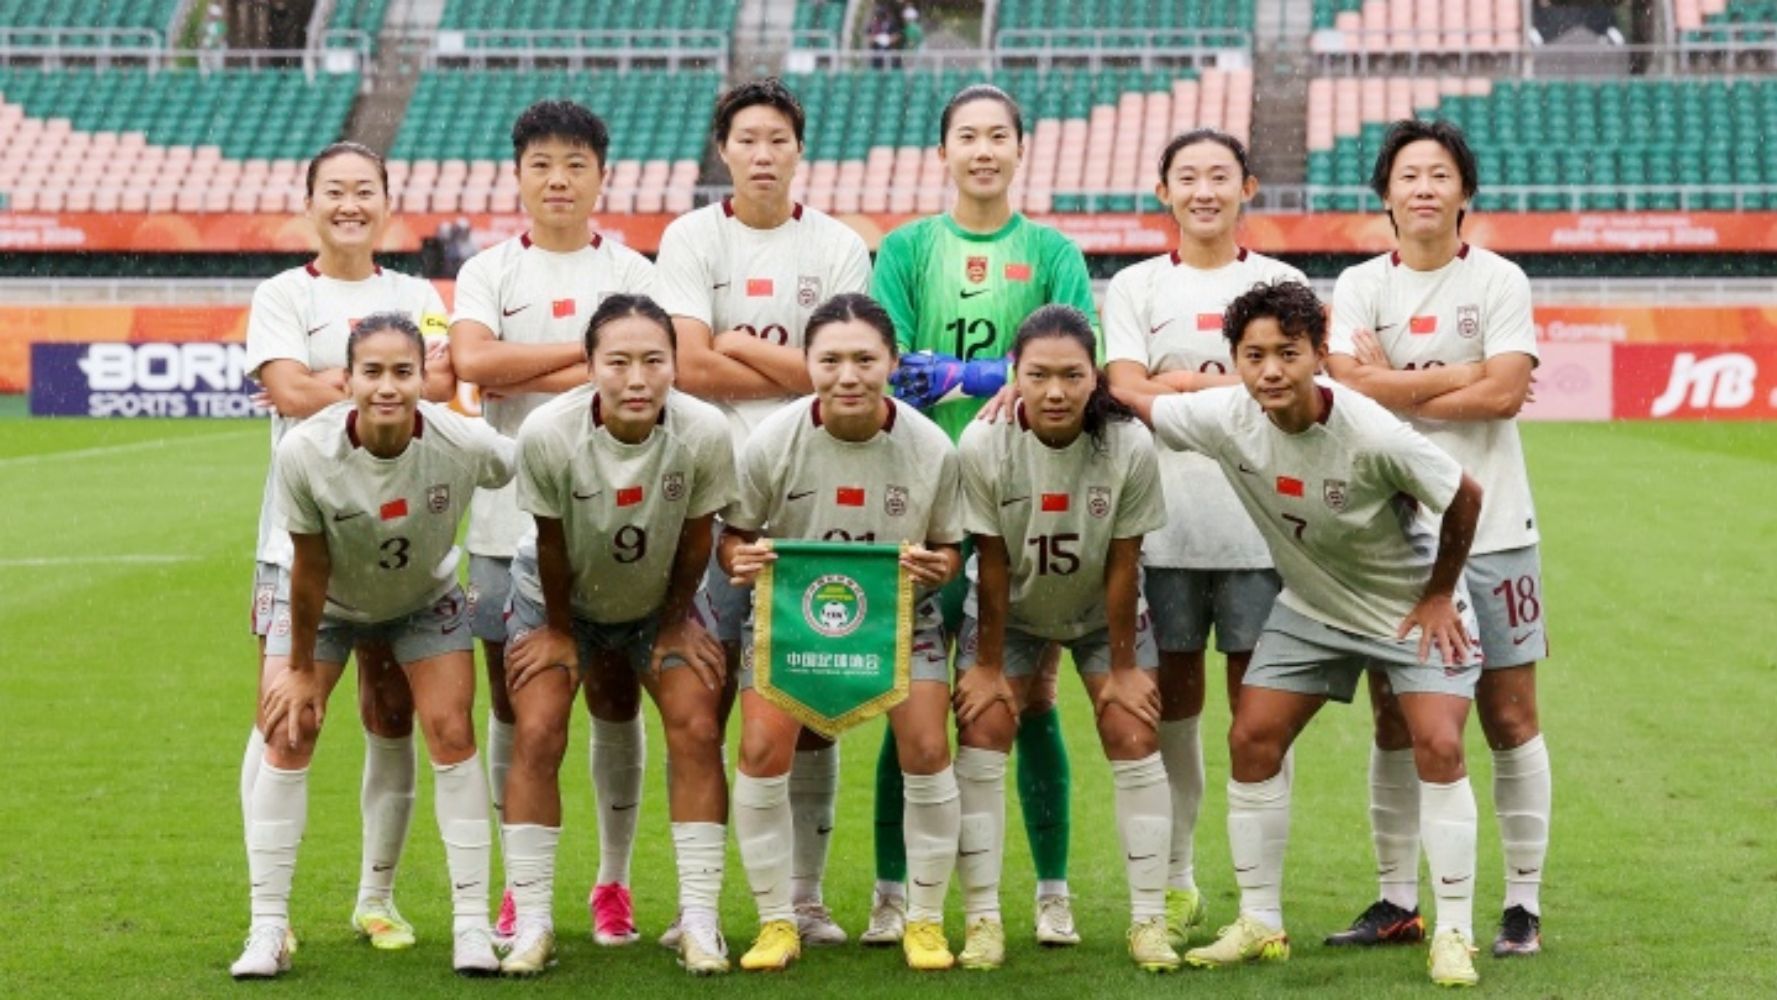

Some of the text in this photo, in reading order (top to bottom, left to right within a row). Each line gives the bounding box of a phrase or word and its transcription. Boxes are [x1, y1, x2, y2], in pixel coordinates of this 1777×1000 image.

[945, 317, 997, 362] 12
[88, 391, 187, 416] SPORTS
[1650, 352, 1758, 417] JTB
[613, 525, 646, 563] 9
[1281, 512, 1307, 542] 7
[379, 536, 410, 569] 3
[1028, 533, 1080, 576] 15
[1493, 575, 1540, 628] 18
